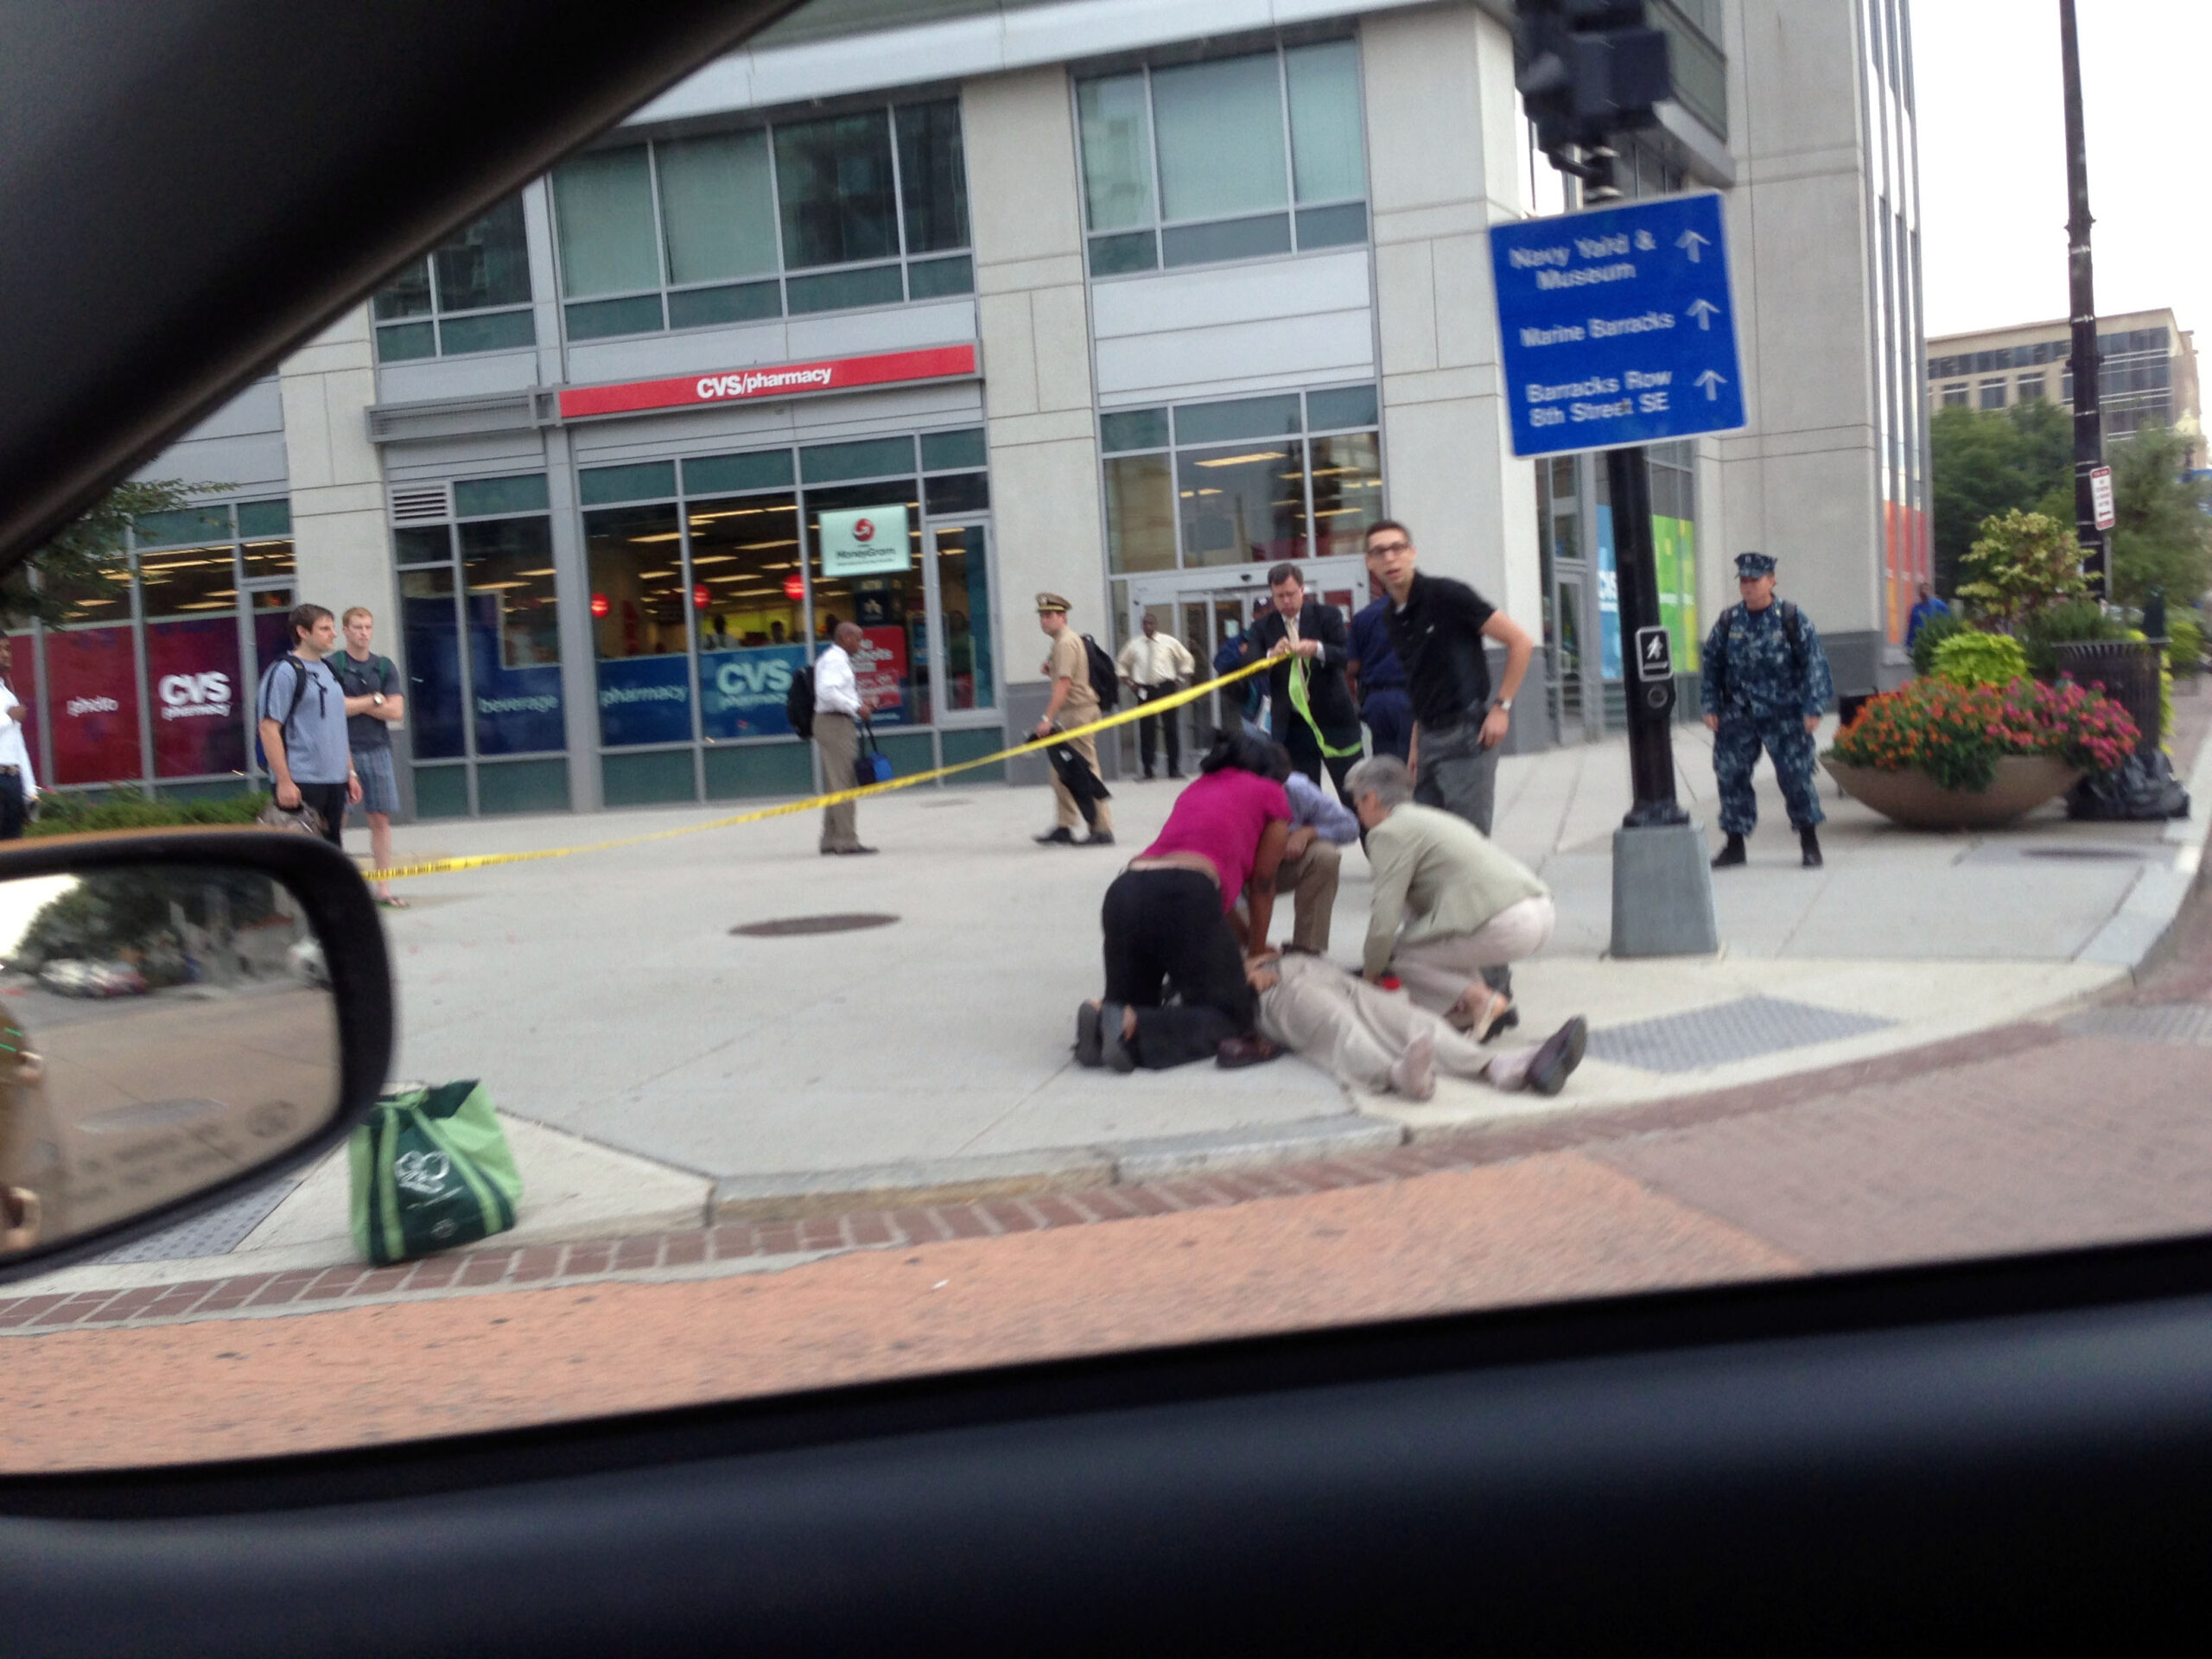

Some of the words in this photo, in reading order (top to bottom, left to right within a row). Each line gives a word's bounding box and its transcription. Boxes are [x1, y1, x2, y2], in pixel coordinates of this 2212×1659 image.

[1509, 247, 1570, 270] Navy
[1573, 232, 1630, 259] Yard
[1634, 228, 1656, 251] &
[1535, 262, 1637, 290] Museum
[1519, 324, 1586, 346] Marine
[1587, 311, 1676, 339] Barracks
[696, 367, 832, 398] CVS/pharmacy
[1525, 376, 1621, 404] Barracks
[1624, 370, 1673, 390] Row
[1529, 406, 1566, 428] 8th
[1569, 397, 1634, 423] Street
[1638, 391, 1670, 413] SE
[158, 671, 232, 706] CVS
[715, 658, 793, 695] CVS
[601, 685, 688, 708] pharmacy
